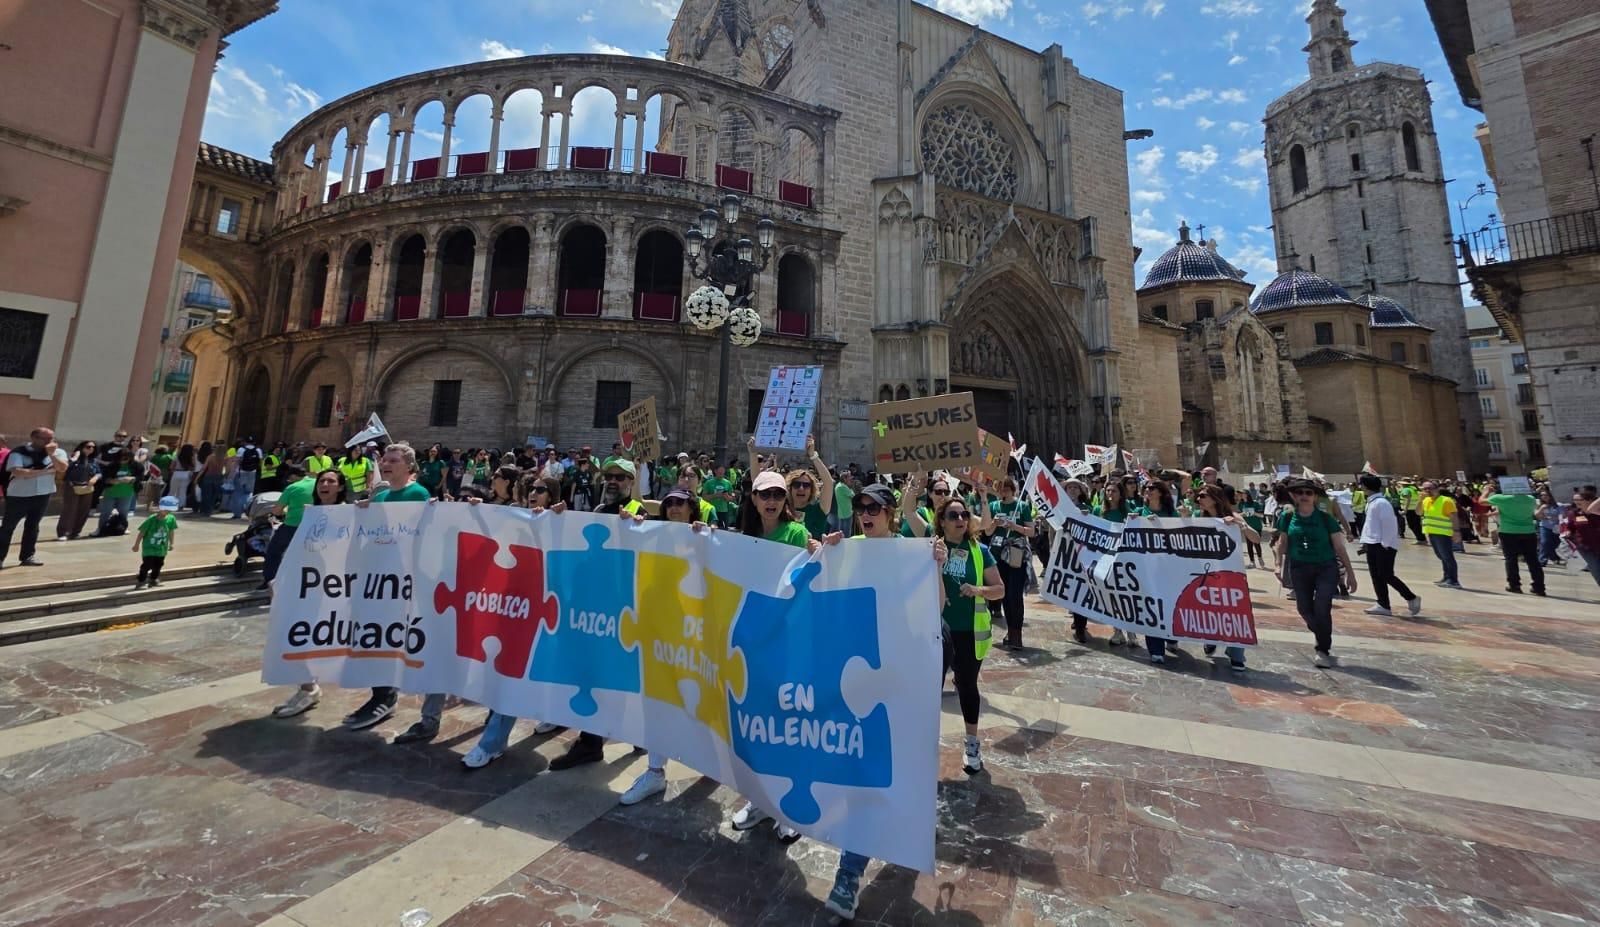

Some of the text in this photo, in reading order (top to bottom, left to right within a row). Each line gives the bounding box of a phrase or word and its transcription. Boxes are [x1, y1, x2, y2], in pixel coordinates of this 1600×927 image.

[887, 403, 973, 431] MESURES
[892, 441, 972, 463] EXCUSES
[1070, 523, 1088, 542] UNA
[1145, 532, 1150, 548] I
[1153, 533, 1166, 549] DE
[1169, 533, 1220, 552] QUALITAT
[300, 566, 412, 601] Per una
[1047, 568, 1166, 630] RETALLADES!
[1195, 586, 1243, 607] CEIP
[465, 589, 530, 620] PÚBLICA
[569, 607, 616, 638] LAICA
[682, 614, 704, 641] DE
[1179, 607, 1253, 639] VALLDIGNA
[653, 639, 719, 689] QUALITAT
[778, 682, 815, 712] EN
[737, 709, 864, 759] VALENCIÀ
